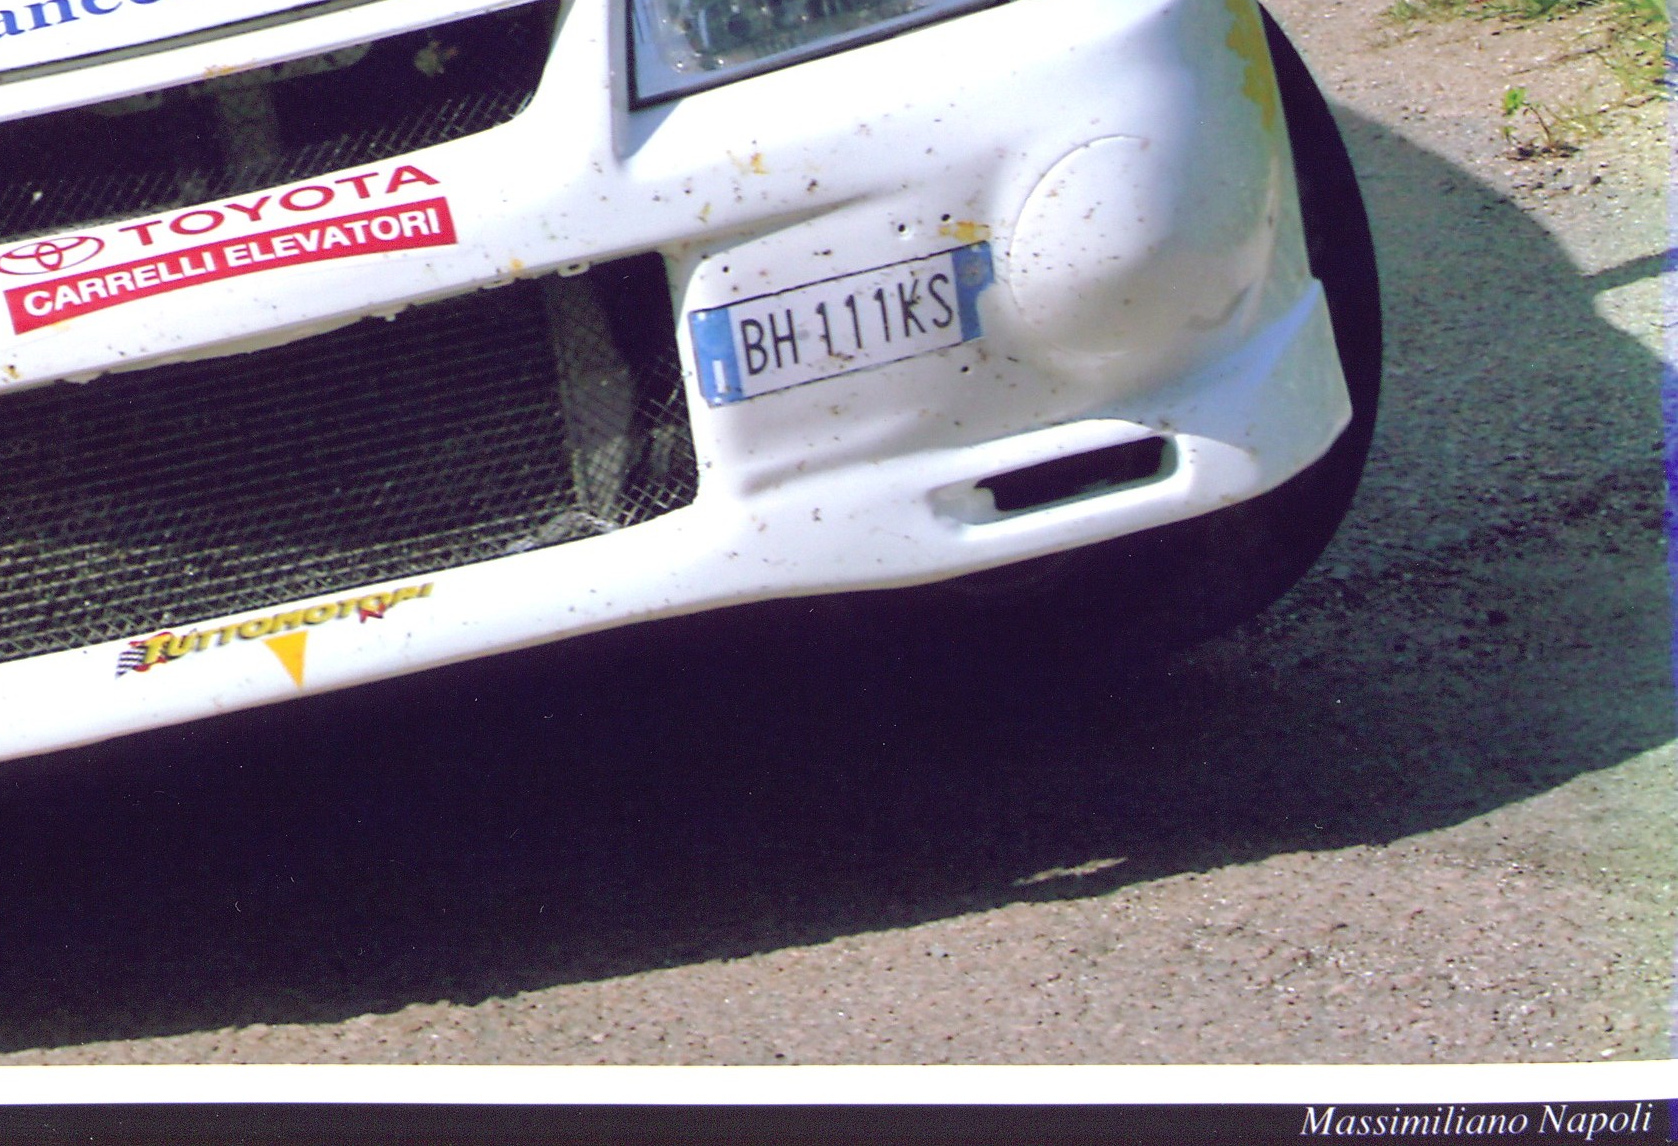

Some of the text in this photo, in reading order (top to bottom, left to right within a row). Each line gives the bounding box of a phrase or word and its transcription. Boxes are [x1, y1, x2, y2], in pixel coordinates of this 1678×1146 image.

[118, 165, 441, 248] TOYOTA
[23, 207, 441, 317] CARRELLI ELEVATORI
[739, 272, 955, 377] BH 111KS
